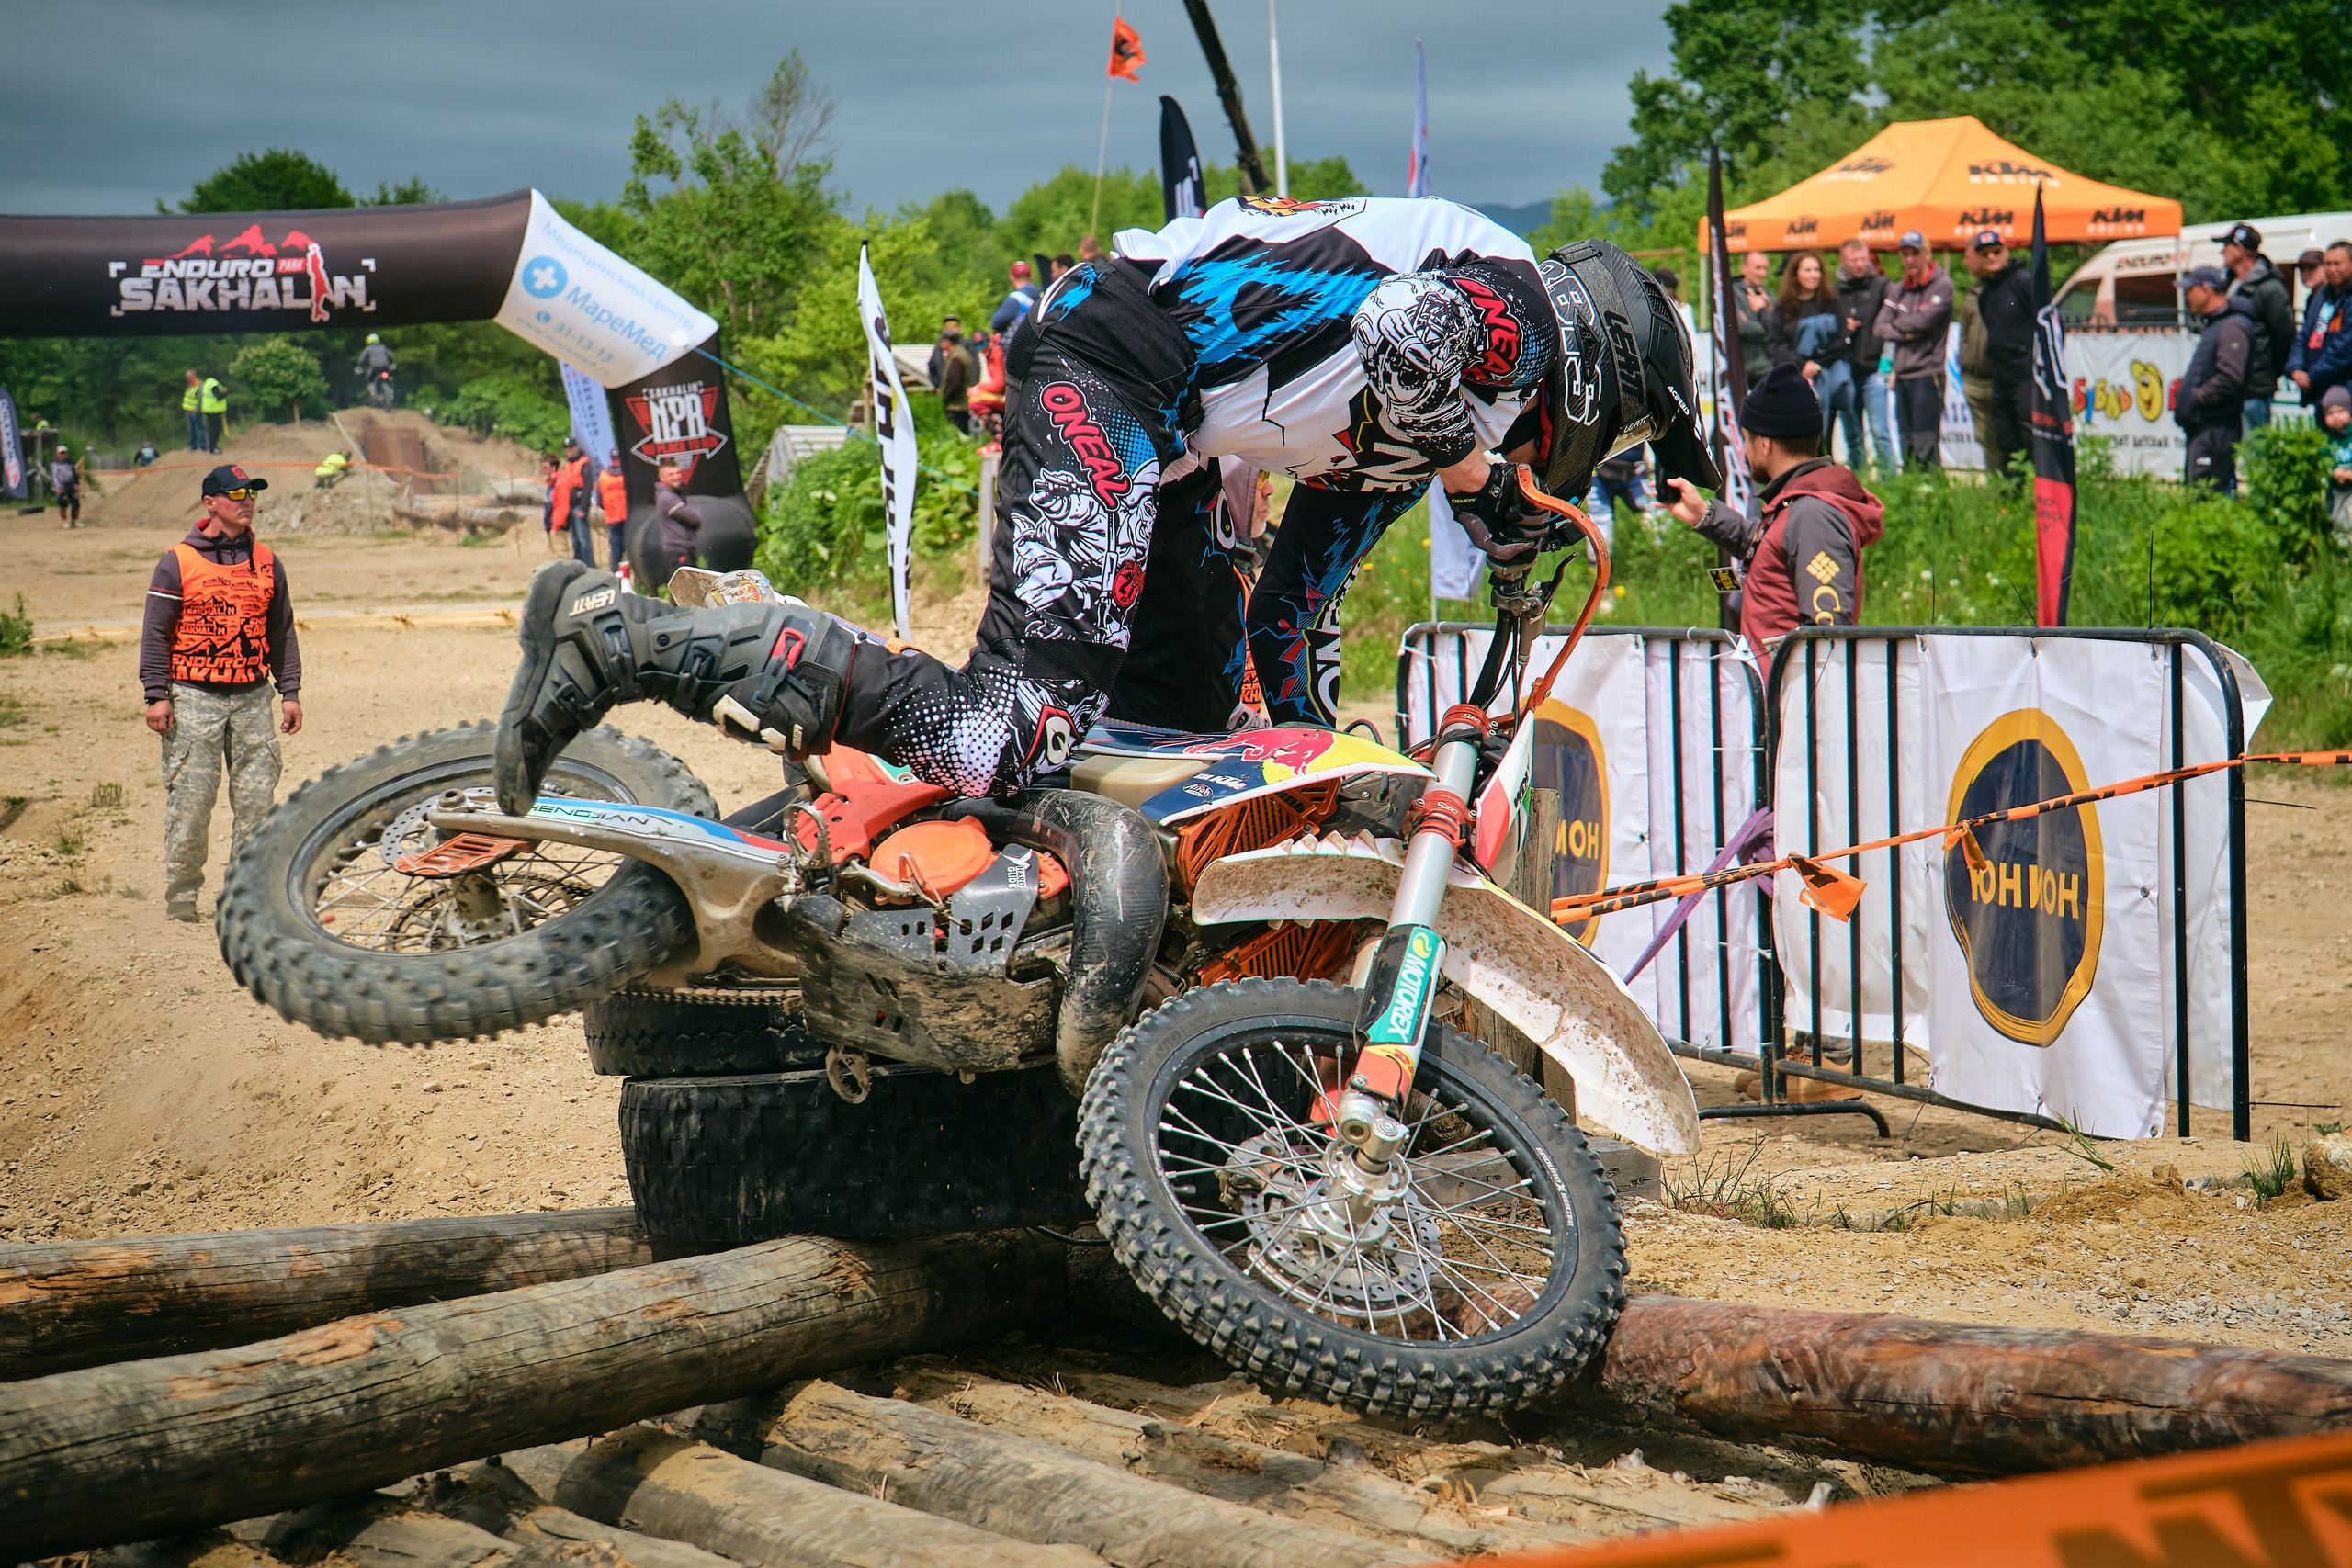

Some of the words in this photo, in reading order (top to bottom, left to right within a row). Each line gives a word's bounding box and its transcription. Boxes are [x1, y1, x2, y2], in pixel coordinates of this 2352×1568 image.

[1958, 208, 2014, 226] KTM
[2091, 208, 2145, 224] KTM
[554, 321, 614, 364] 31-13-13
[565, 285, 668, 362] МареМед
[1042, 382, 1132, 510] ONEAL
[568, 589, 616, 617] LEATT
[1387, 953, 1428, 1043] MOTOREX
